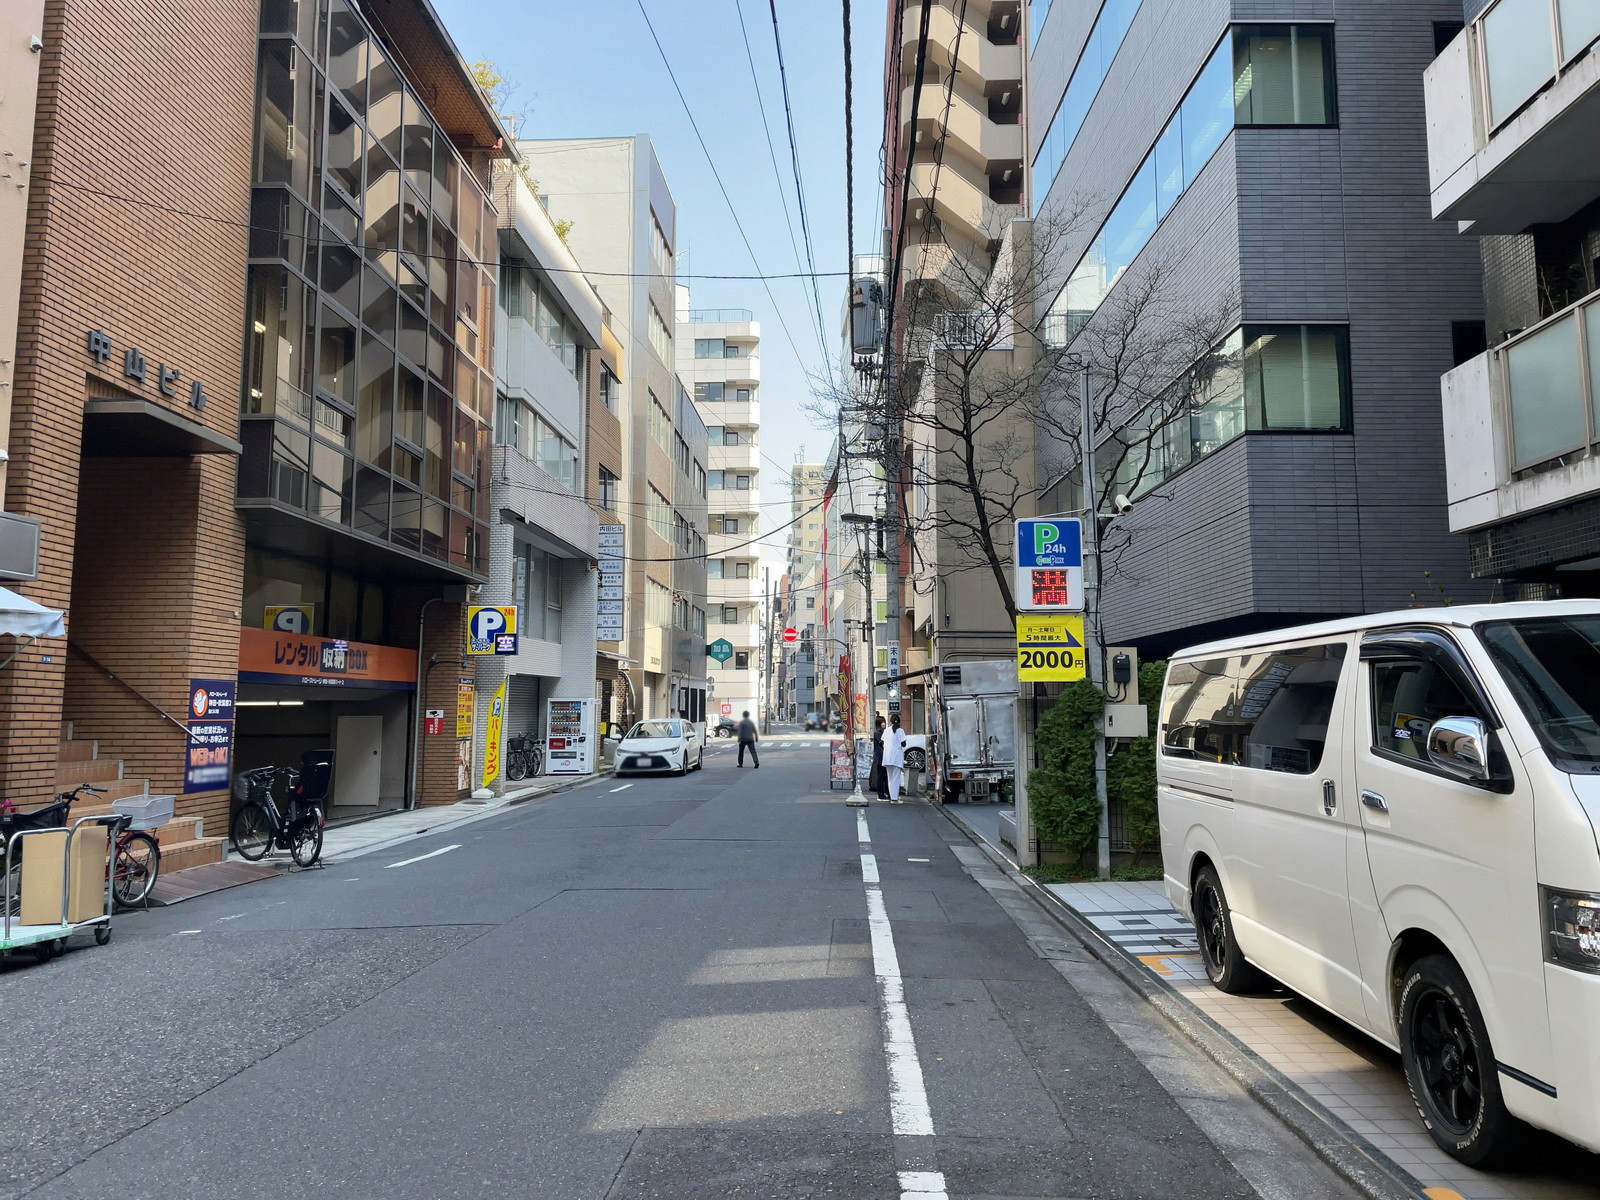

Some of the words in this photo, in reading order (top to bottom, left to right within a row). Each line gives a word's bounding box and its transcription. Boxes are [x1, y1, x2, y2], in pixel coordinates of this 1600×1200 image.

[87, 328, 207, 411] 中山ビル
[1034, 523, 1060, 554] P
[1045, 543, 1066, 554] 24h
[478, 611, 504, 639] P
[503, 608, 515, 617] 24h
[497, 635, 515, 652] 空
[1020, 650, 1084, 669] 2000円
[486, 718, 500, 776] パーキング
[1398, 972, 1422, 1025] YOKOHAMA
